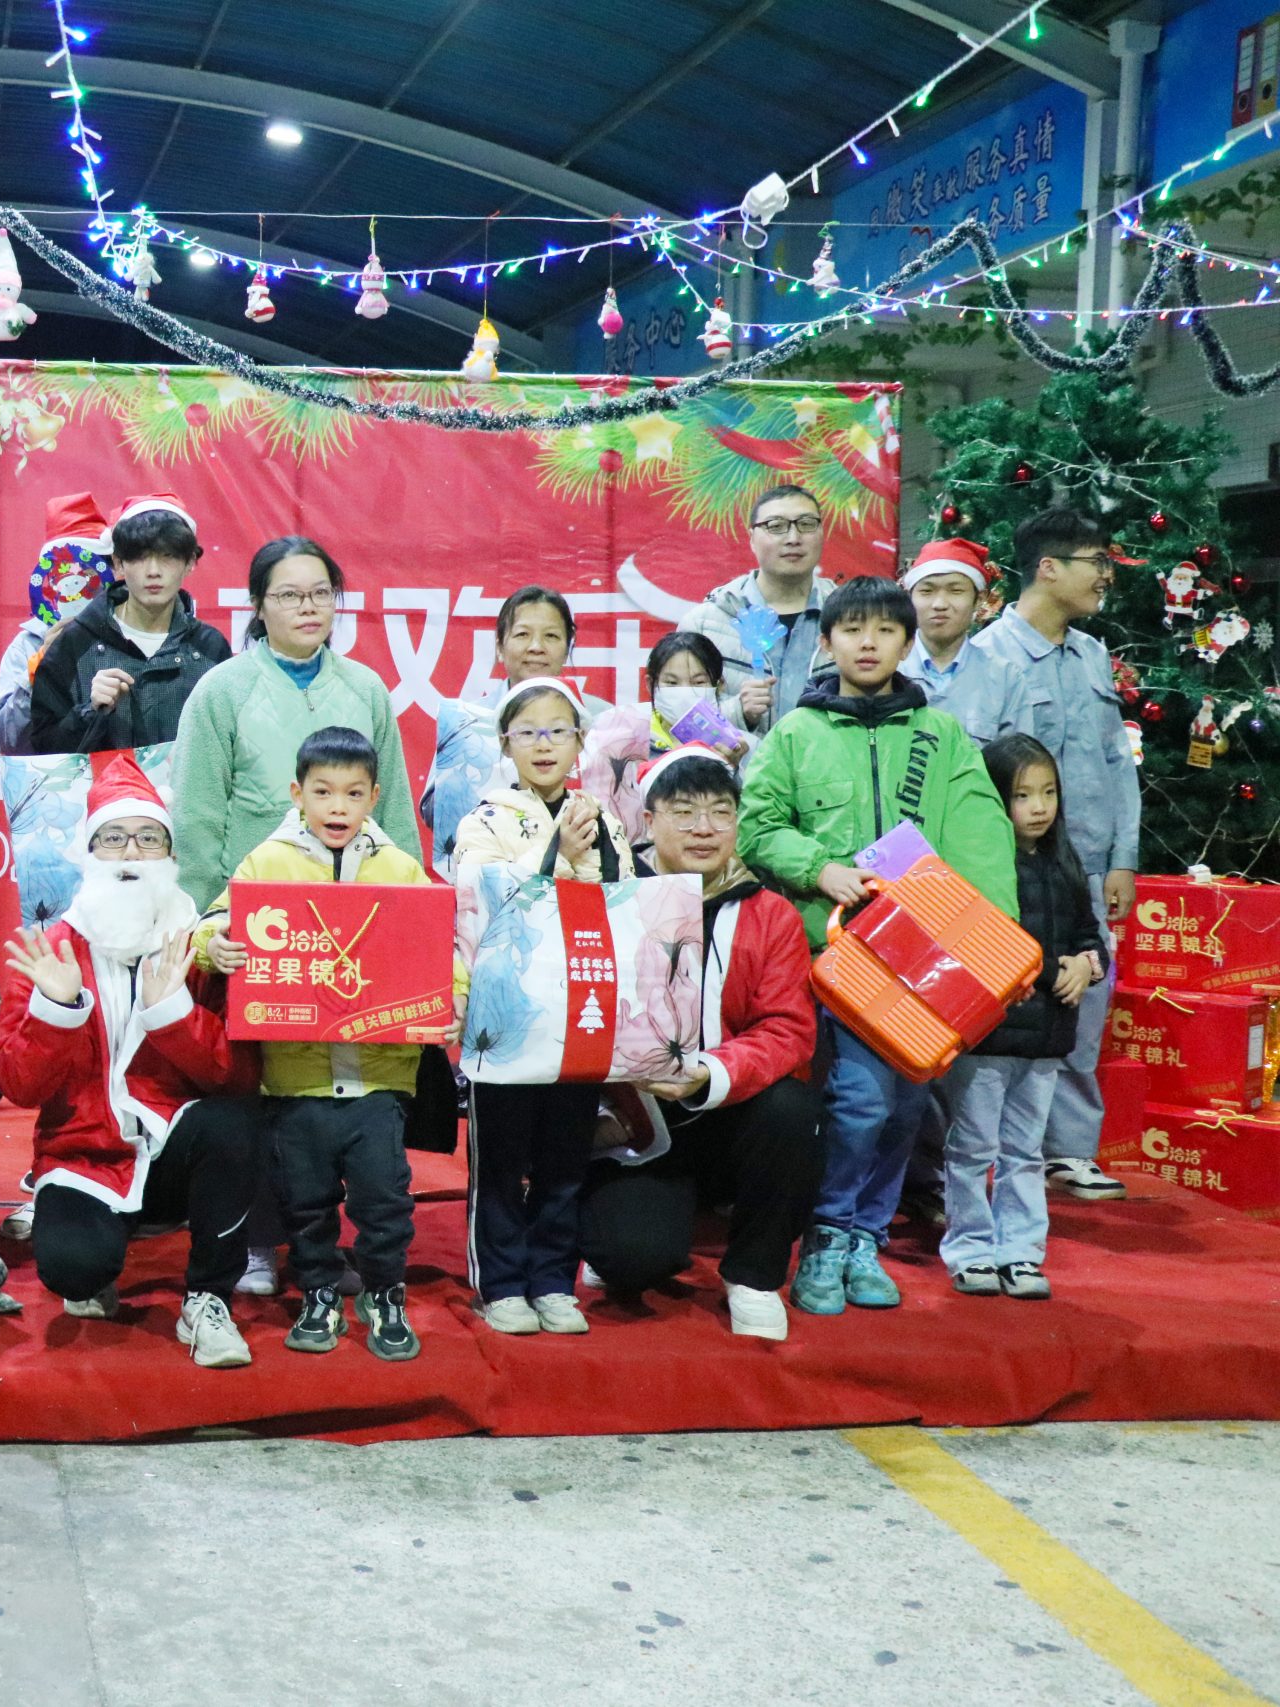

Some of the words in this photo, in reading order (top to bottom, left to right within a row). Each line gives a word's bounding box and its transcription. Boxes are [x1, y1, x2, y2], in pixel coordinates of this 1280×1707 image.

[289, 930, 333, 953] 洽洽
[245, 957, 373, 986] 坚果锦礼
